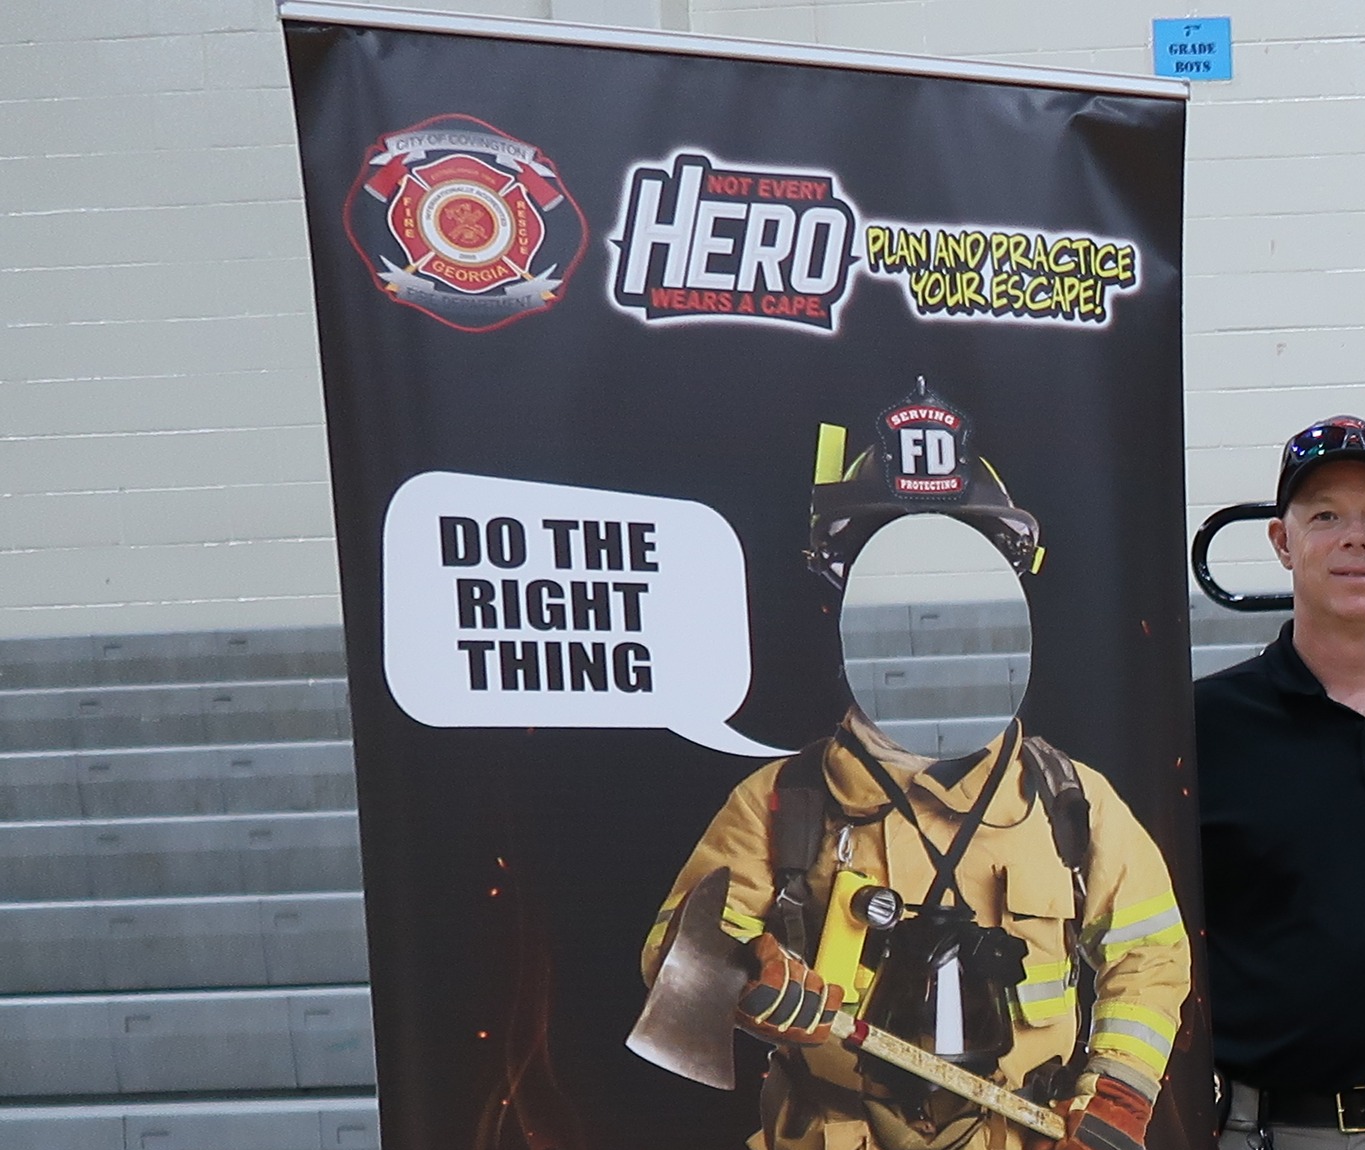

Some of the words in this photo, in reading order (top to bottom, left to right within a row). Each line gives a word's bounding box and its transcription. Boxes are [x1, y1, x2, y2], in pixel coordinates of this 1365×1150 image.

[1168, 43, 1216, 54] GRADE
[1174, 61, 1211, 72] BOYS
[707, 175, 752, 196] NOT
[757, 178, 827, 200] EVERY
[403, 197, 414, 239] FIRE
[516, 201, 527, 255] RESCUE
[623, 165, 848, 294] HERO
[432, 260, 509, 283] GEORGIA
[866, 226, 931, 272] PLAN
[933, 230, 986, 274] AND
[990, 232, 1135, 285] PRACTICE
[650, 288, 733, 312] WEARS
[738, 293, 756, 313] A
[762, 295, 826, 317] CAPE.
[910, 269, 987, 312] YOUR
[990, 272, 1104, 319] ESCAPE!
[891, 408, 955, 425] SERVING
[901, 428, 956, 475] FD
[901, 479, 957, 491] PROTECTING
[438, 516, 527, 569] DO
[542, 518, 659, 573] THE
[456, 578, 649, 632] RIGHT
[457, 640, 654, 693] THING
